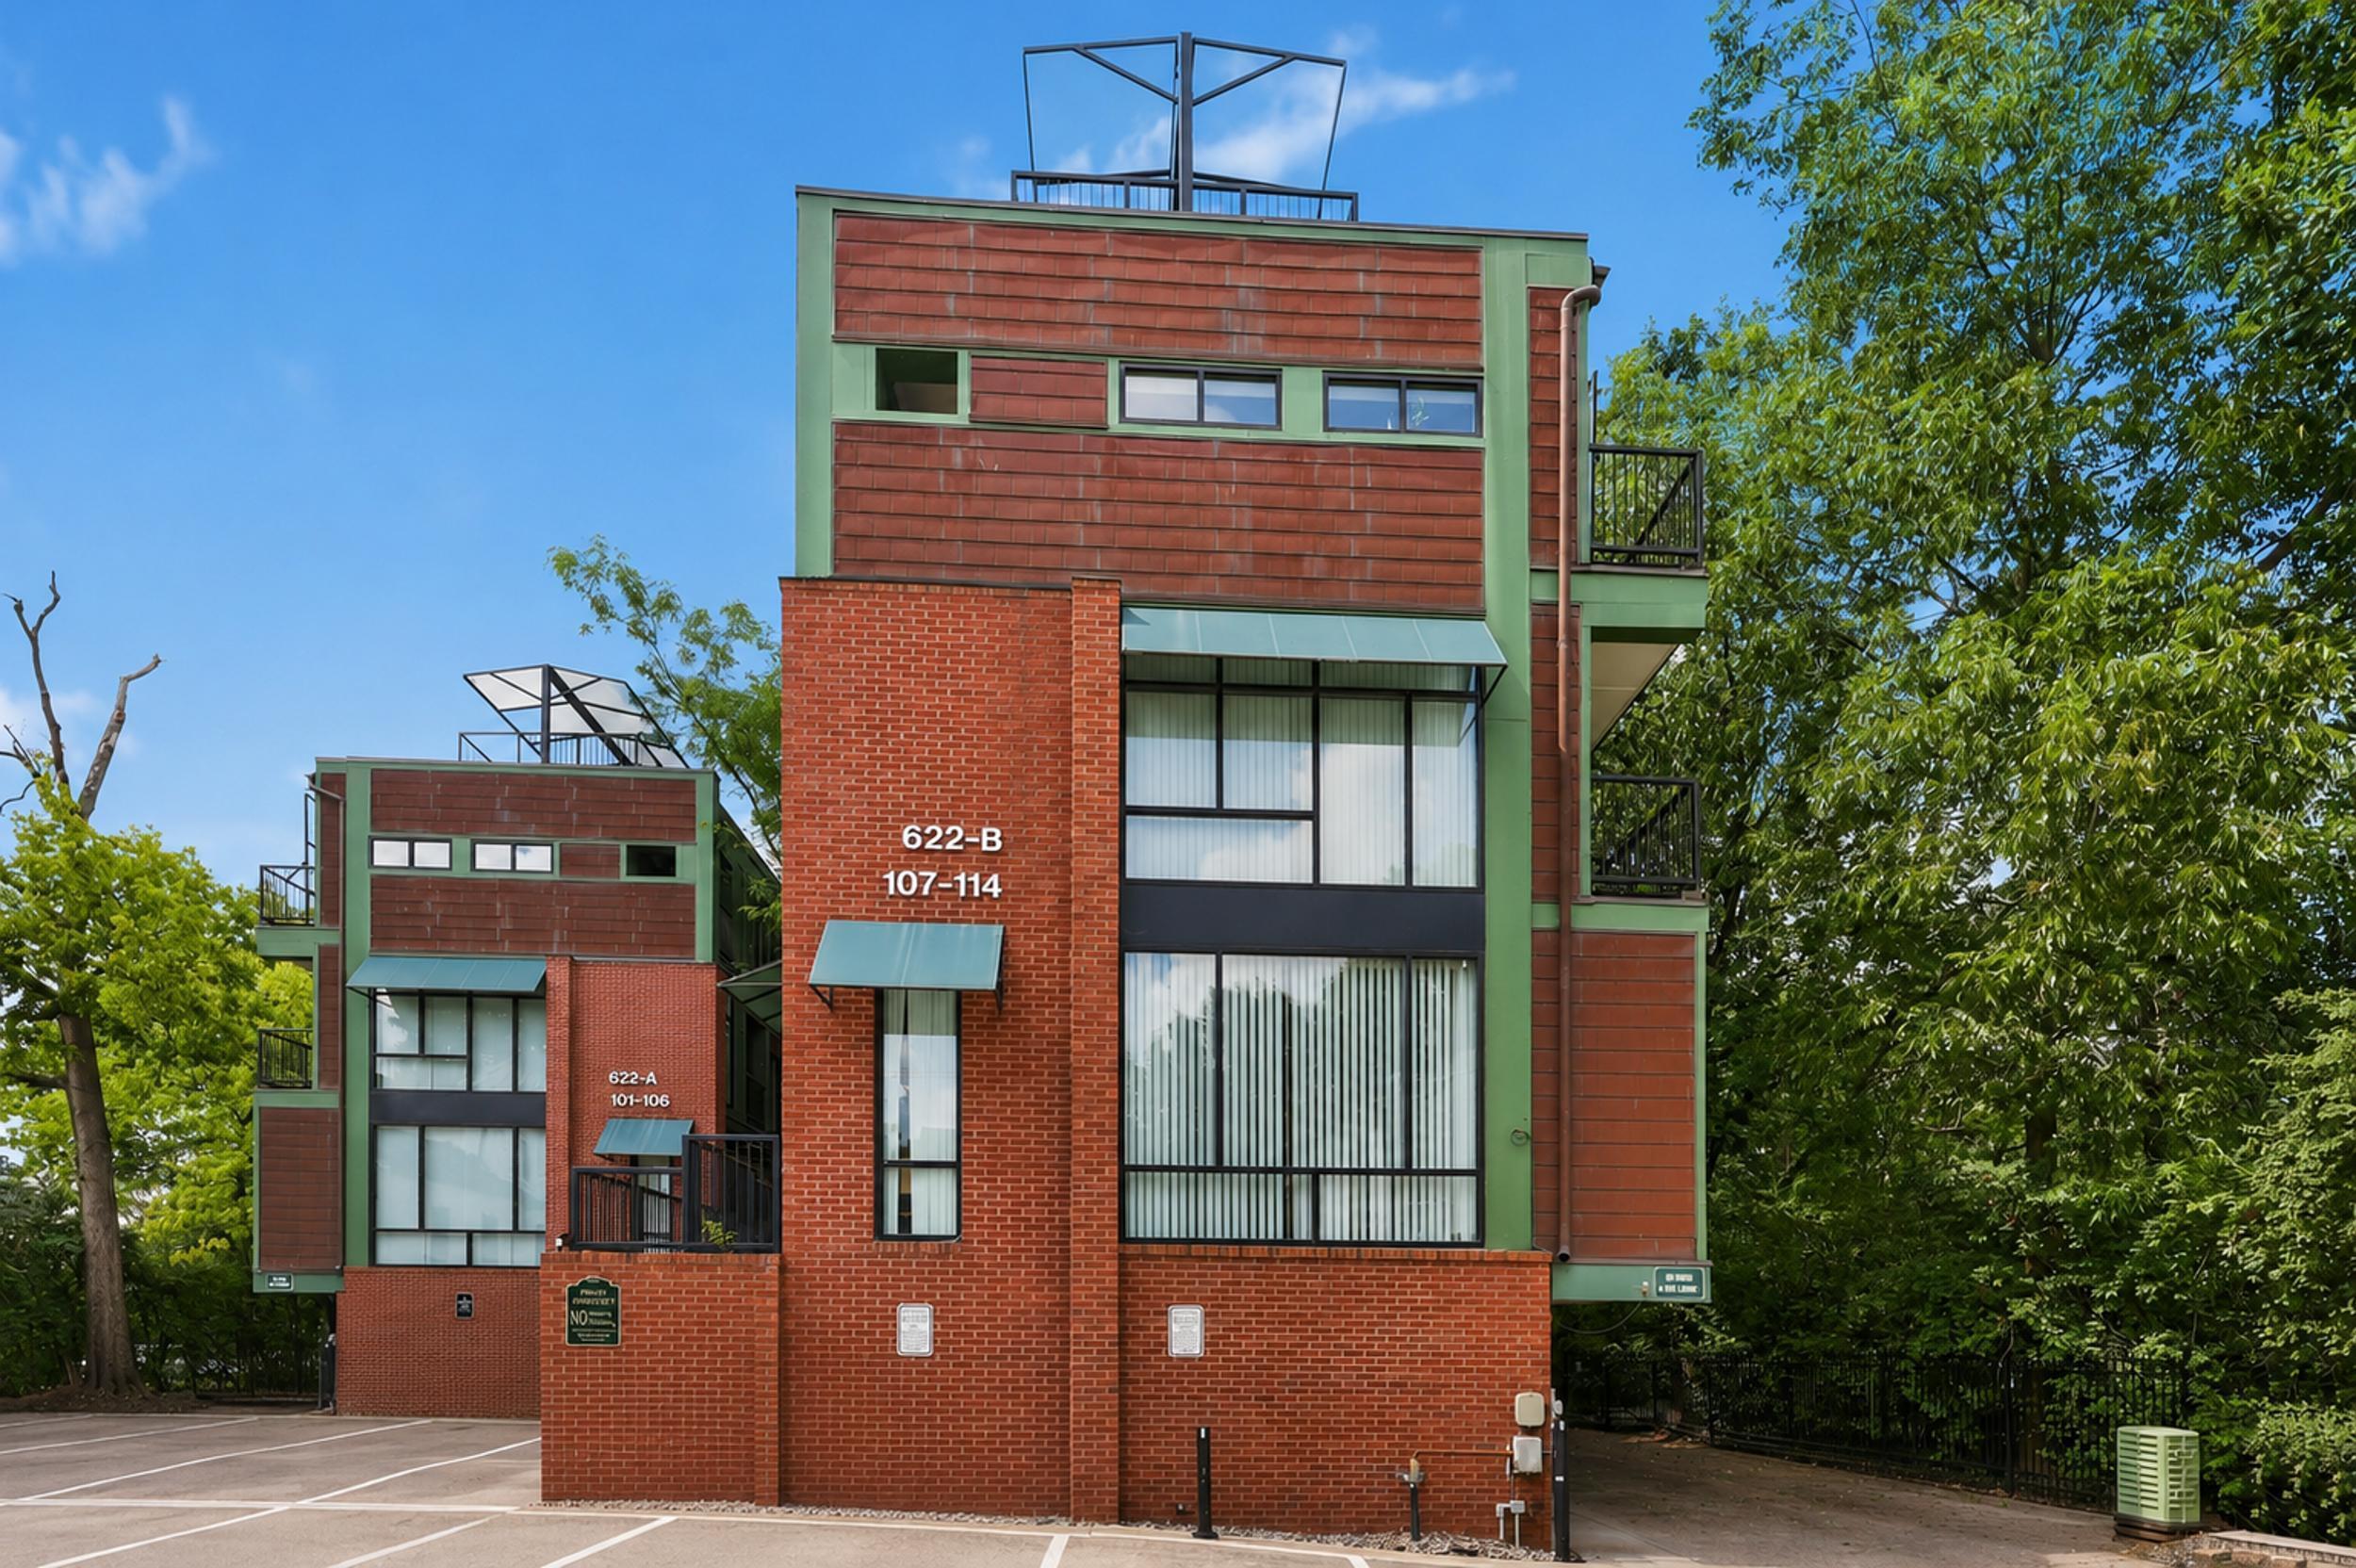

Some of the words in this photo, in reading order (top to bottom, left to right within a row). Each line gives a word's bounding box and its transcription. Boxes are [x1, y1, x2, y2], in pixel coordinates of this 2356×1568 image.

[902, 825, 1002, 852] 622-B
[882, 870, 1003, 898] 107-114
[608, 1070, 658, 1086] 622-A
[611, 1093, 670, 1107] 101-106
[570, 1310, 588, 1326] NO
